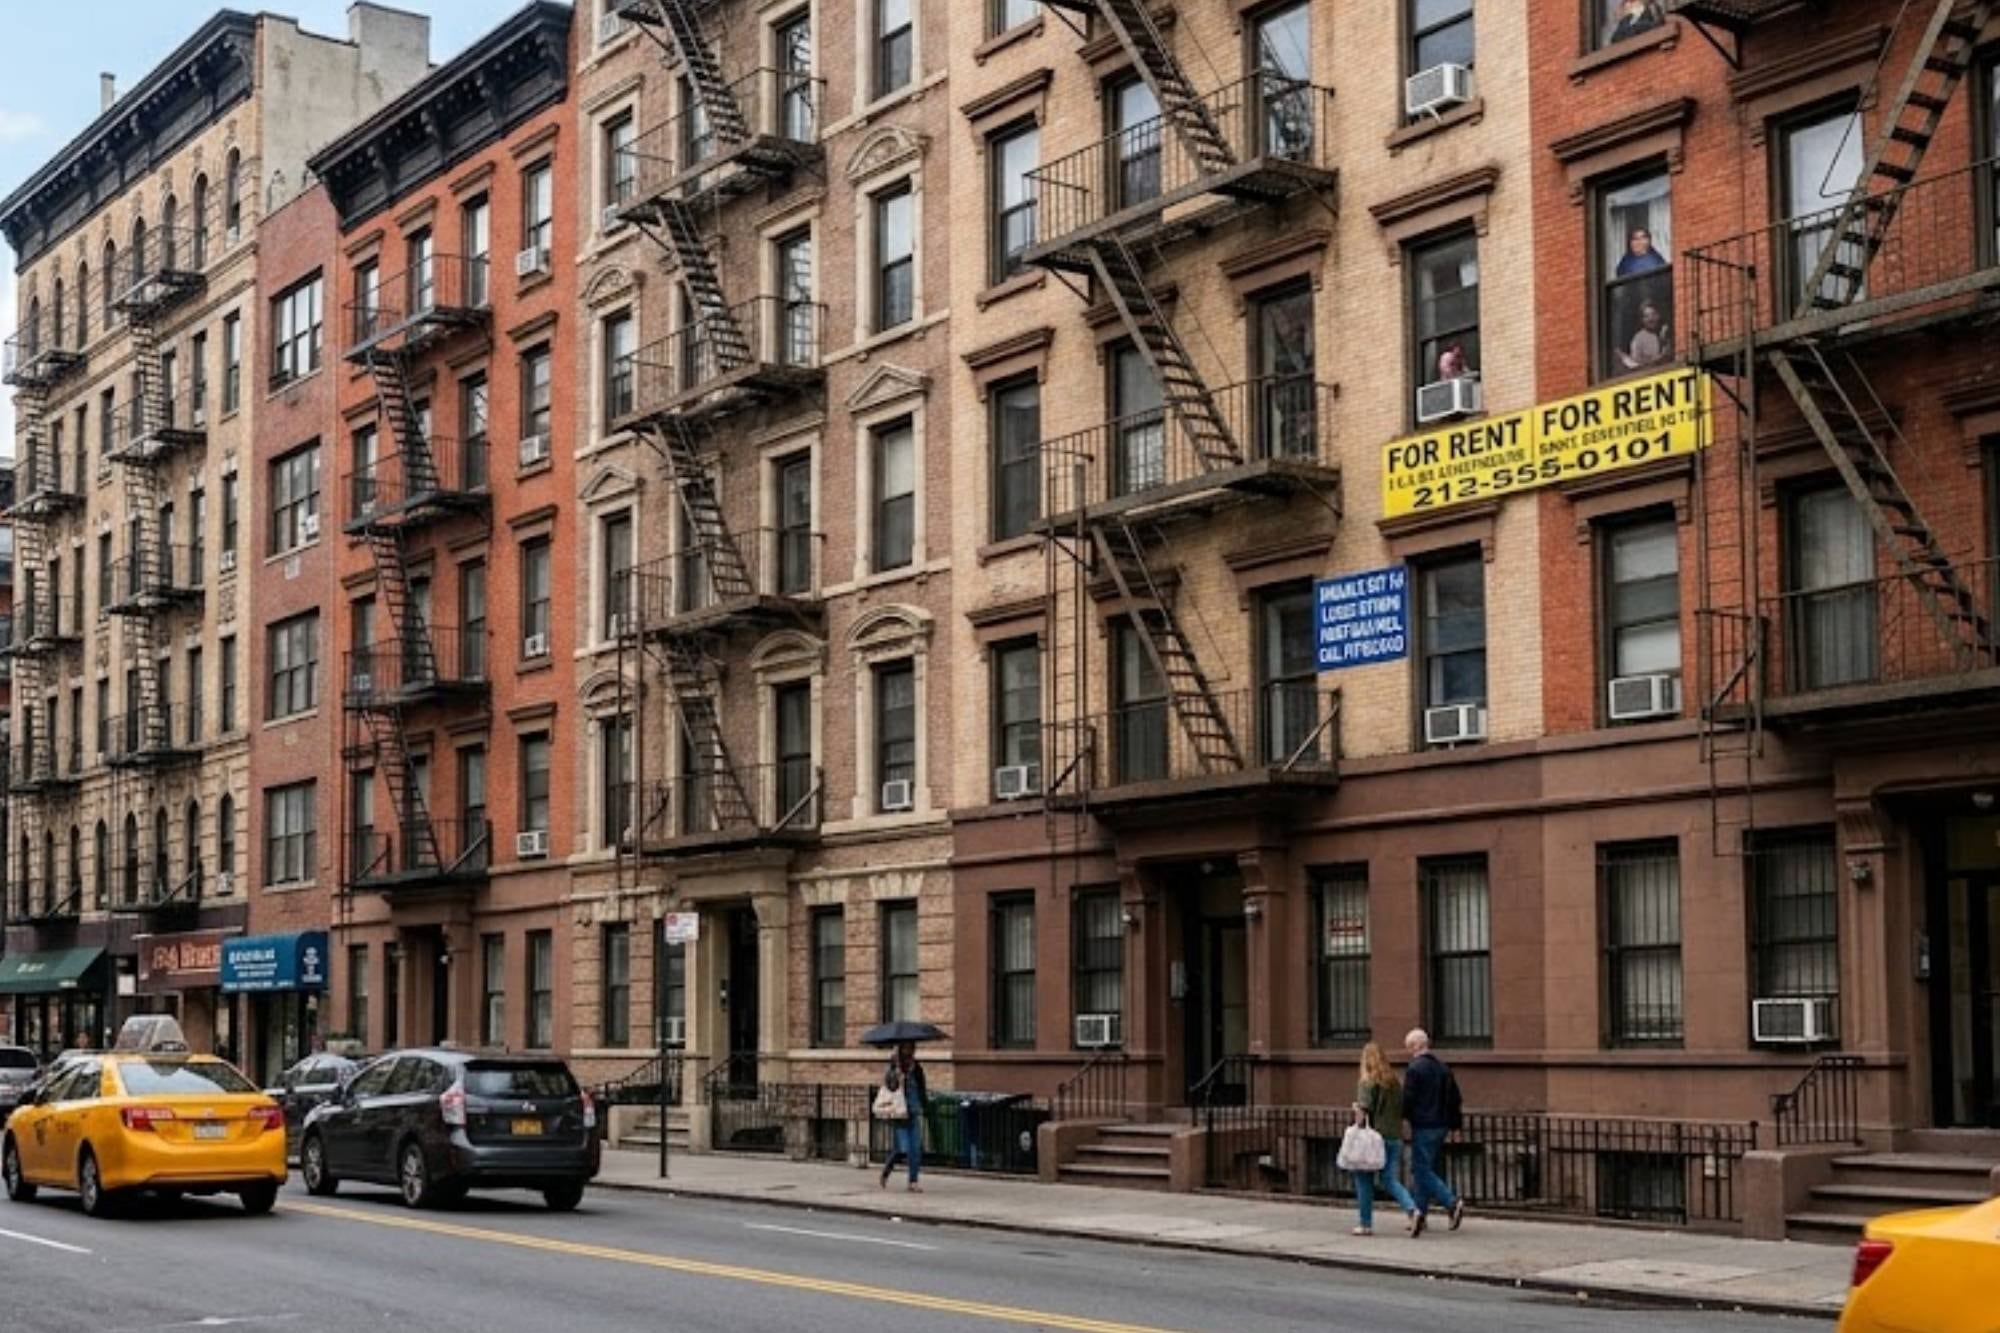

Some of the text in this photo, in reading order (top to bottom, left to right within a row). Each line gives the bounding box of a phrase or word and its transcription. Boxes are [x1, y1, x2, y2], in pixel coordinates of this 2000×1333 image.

[1389, 439, 1439, 473] FOR
[1450, 417, 1522, 459] RENT
[1543, 398, 1601, 436] FOR
[1613, 374, 1696, 420] RENT
